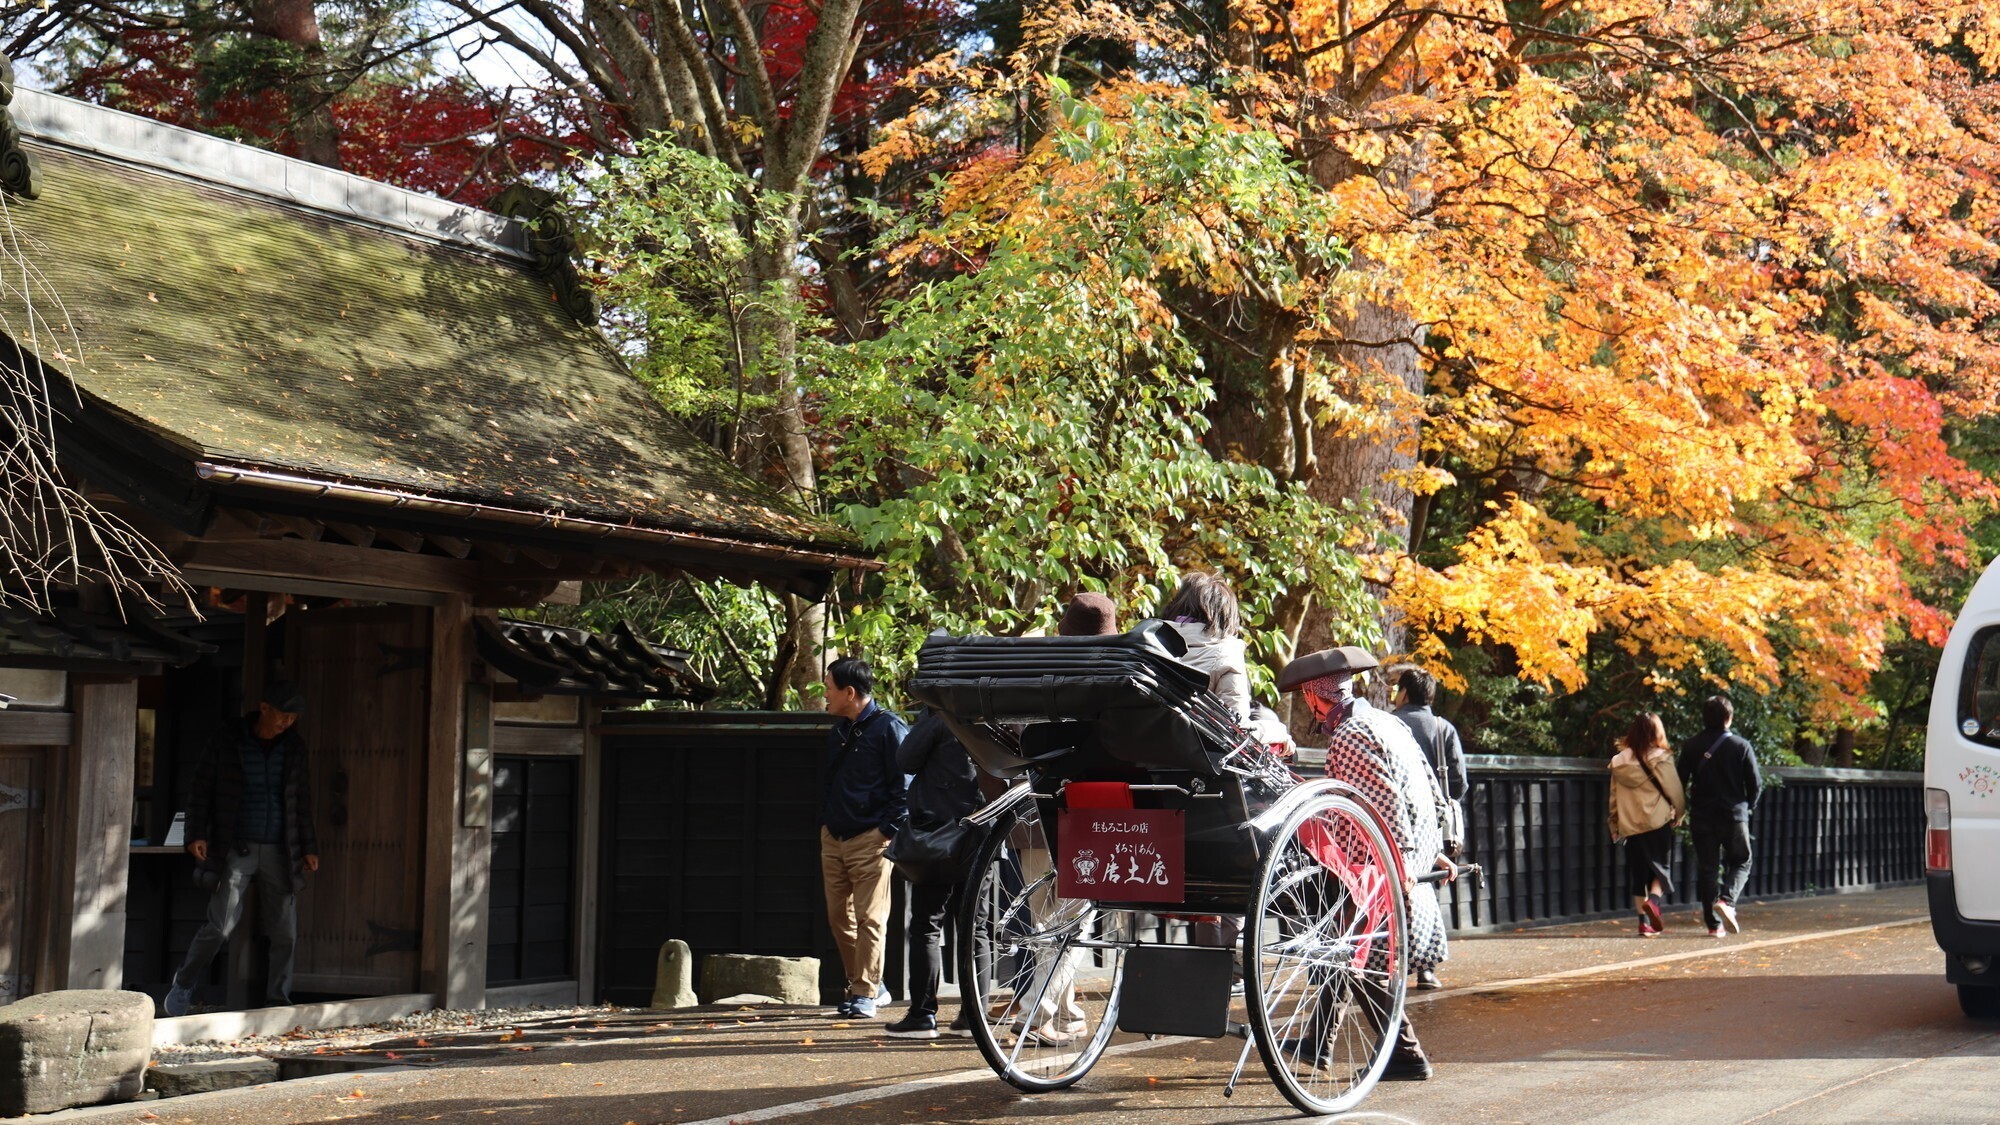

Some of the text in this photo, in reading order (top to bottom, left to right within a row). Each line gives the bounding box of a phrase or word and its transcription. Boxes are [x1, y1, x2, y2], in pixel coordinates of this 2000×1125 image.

[1092, 821, 1149, 834] 生もろこしの店
[1102, 853, 1169, 885] 唐土庵
